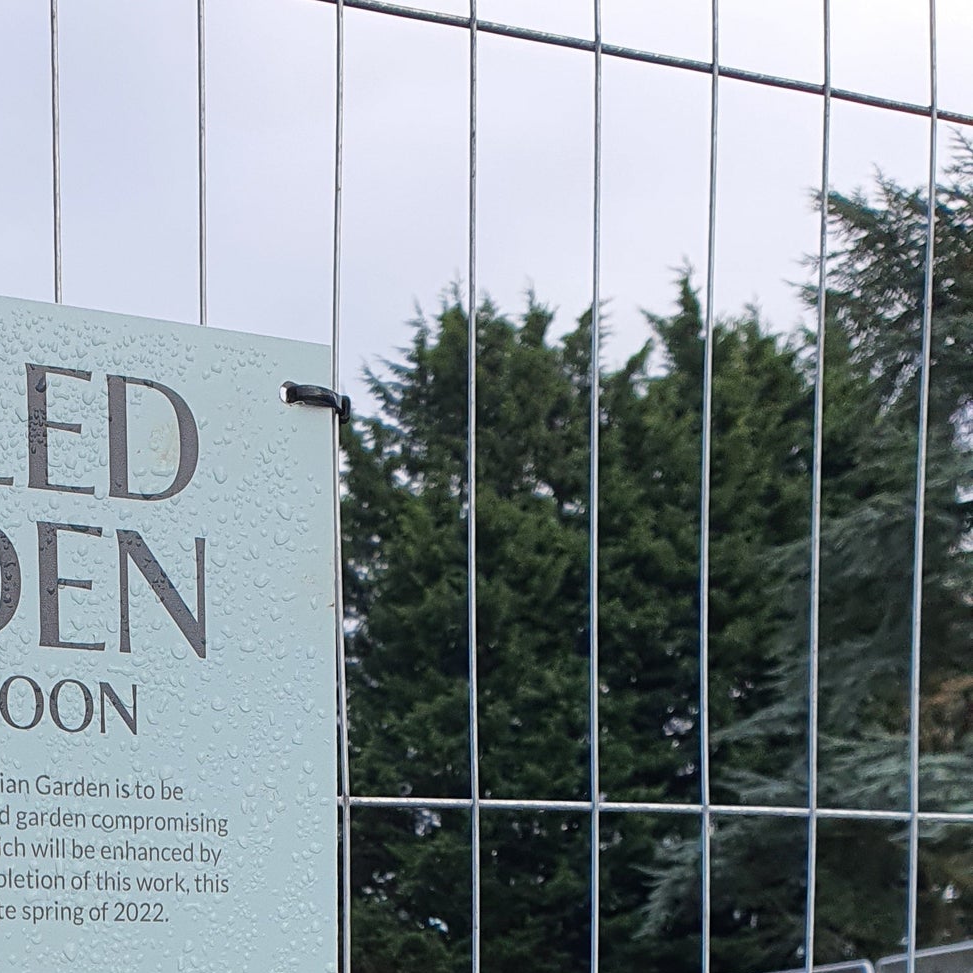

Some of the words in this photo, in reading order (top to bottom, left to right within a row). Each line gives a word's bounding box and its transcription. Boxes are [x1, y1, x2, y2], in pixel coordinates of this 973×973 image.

[35, 774, 110, 798] Garden
[115, 779, 130, 798] is
[135, 781, 155, 799] to
[160, 779, 184, 801] be
[16, 807, 86, 830] garden
[91, 812, 228, 837] compromising
[32, 838, 66, 859] will
[72, 839, 95, 860] be
[100, 841, 194, 862] enhanced
[200, 843, 221, 866] by
[71, 870, 90, 891] of
[96, 871, 131, 892] this
[136, 872, 190, 895] work,
[195, 873, 229, 893] this
[22, 901, 84, 925] spring
[89, 901, 109, 922] of
[114, 902, 169, 923] 2022.
